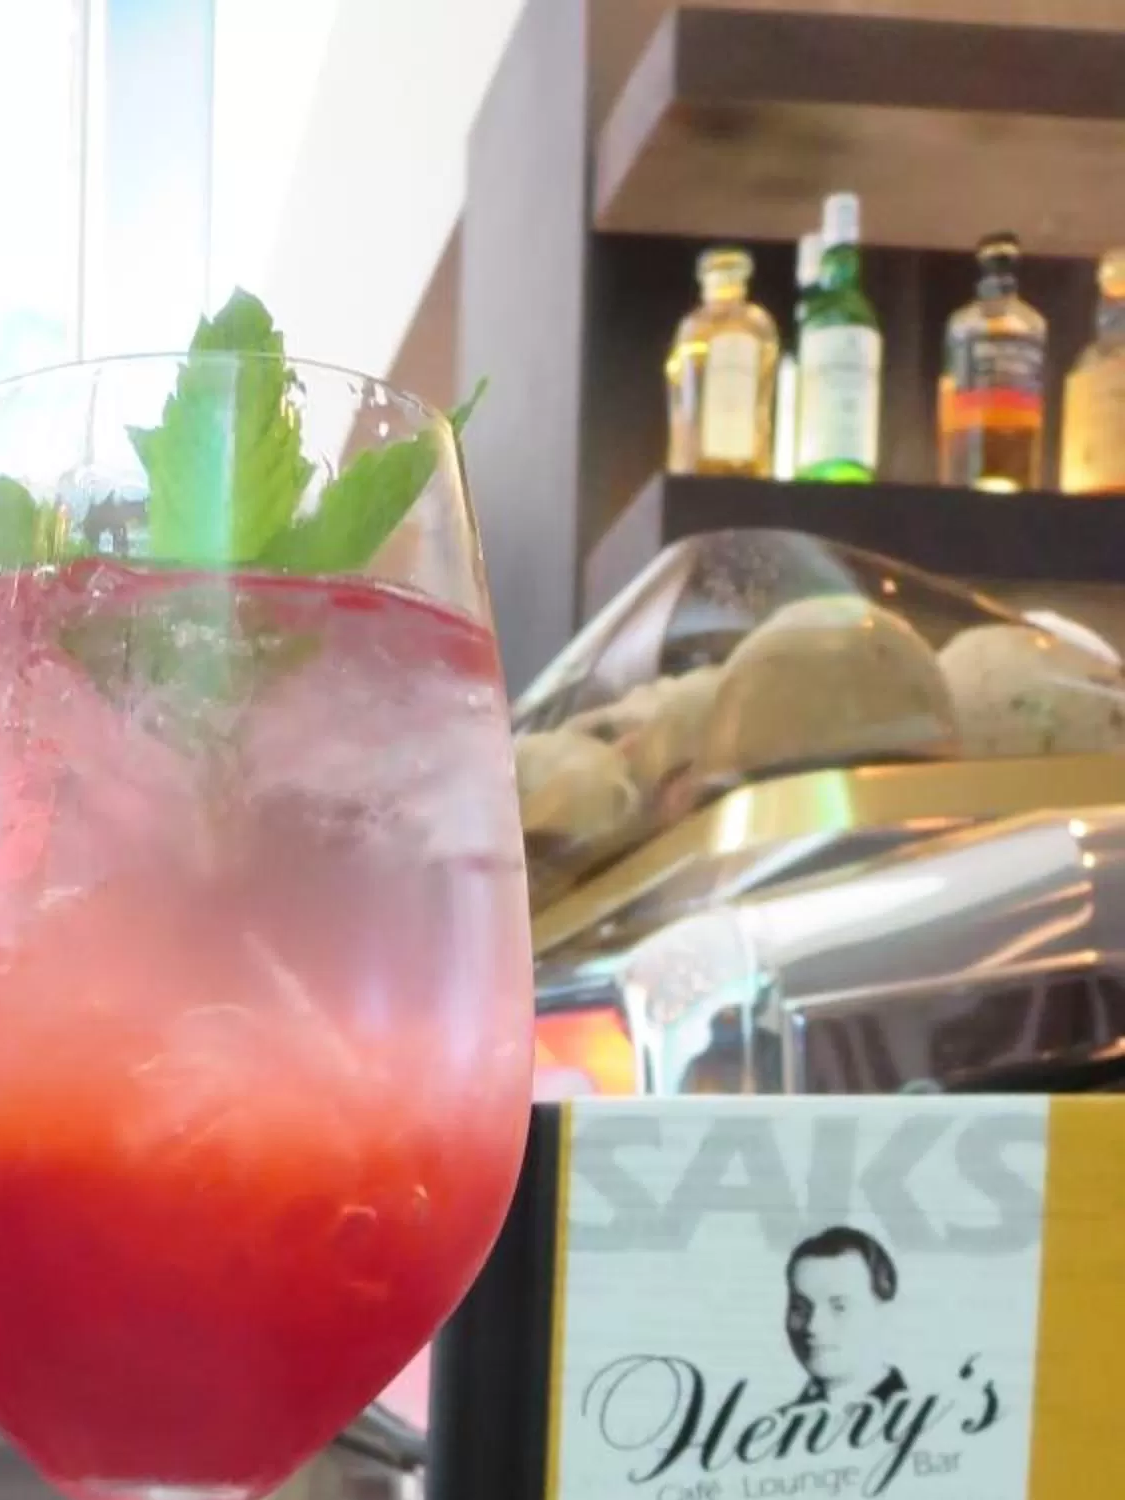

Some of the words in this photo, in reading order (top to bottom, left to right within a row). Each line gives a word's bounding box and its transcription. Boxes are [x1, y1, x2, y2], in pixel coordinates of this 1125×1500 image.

[567, 1113, 1048, 1256] SAKS
[581, 1353, 1000, 1499] Henry's
[913, 1449, 963, 1478] Bar
